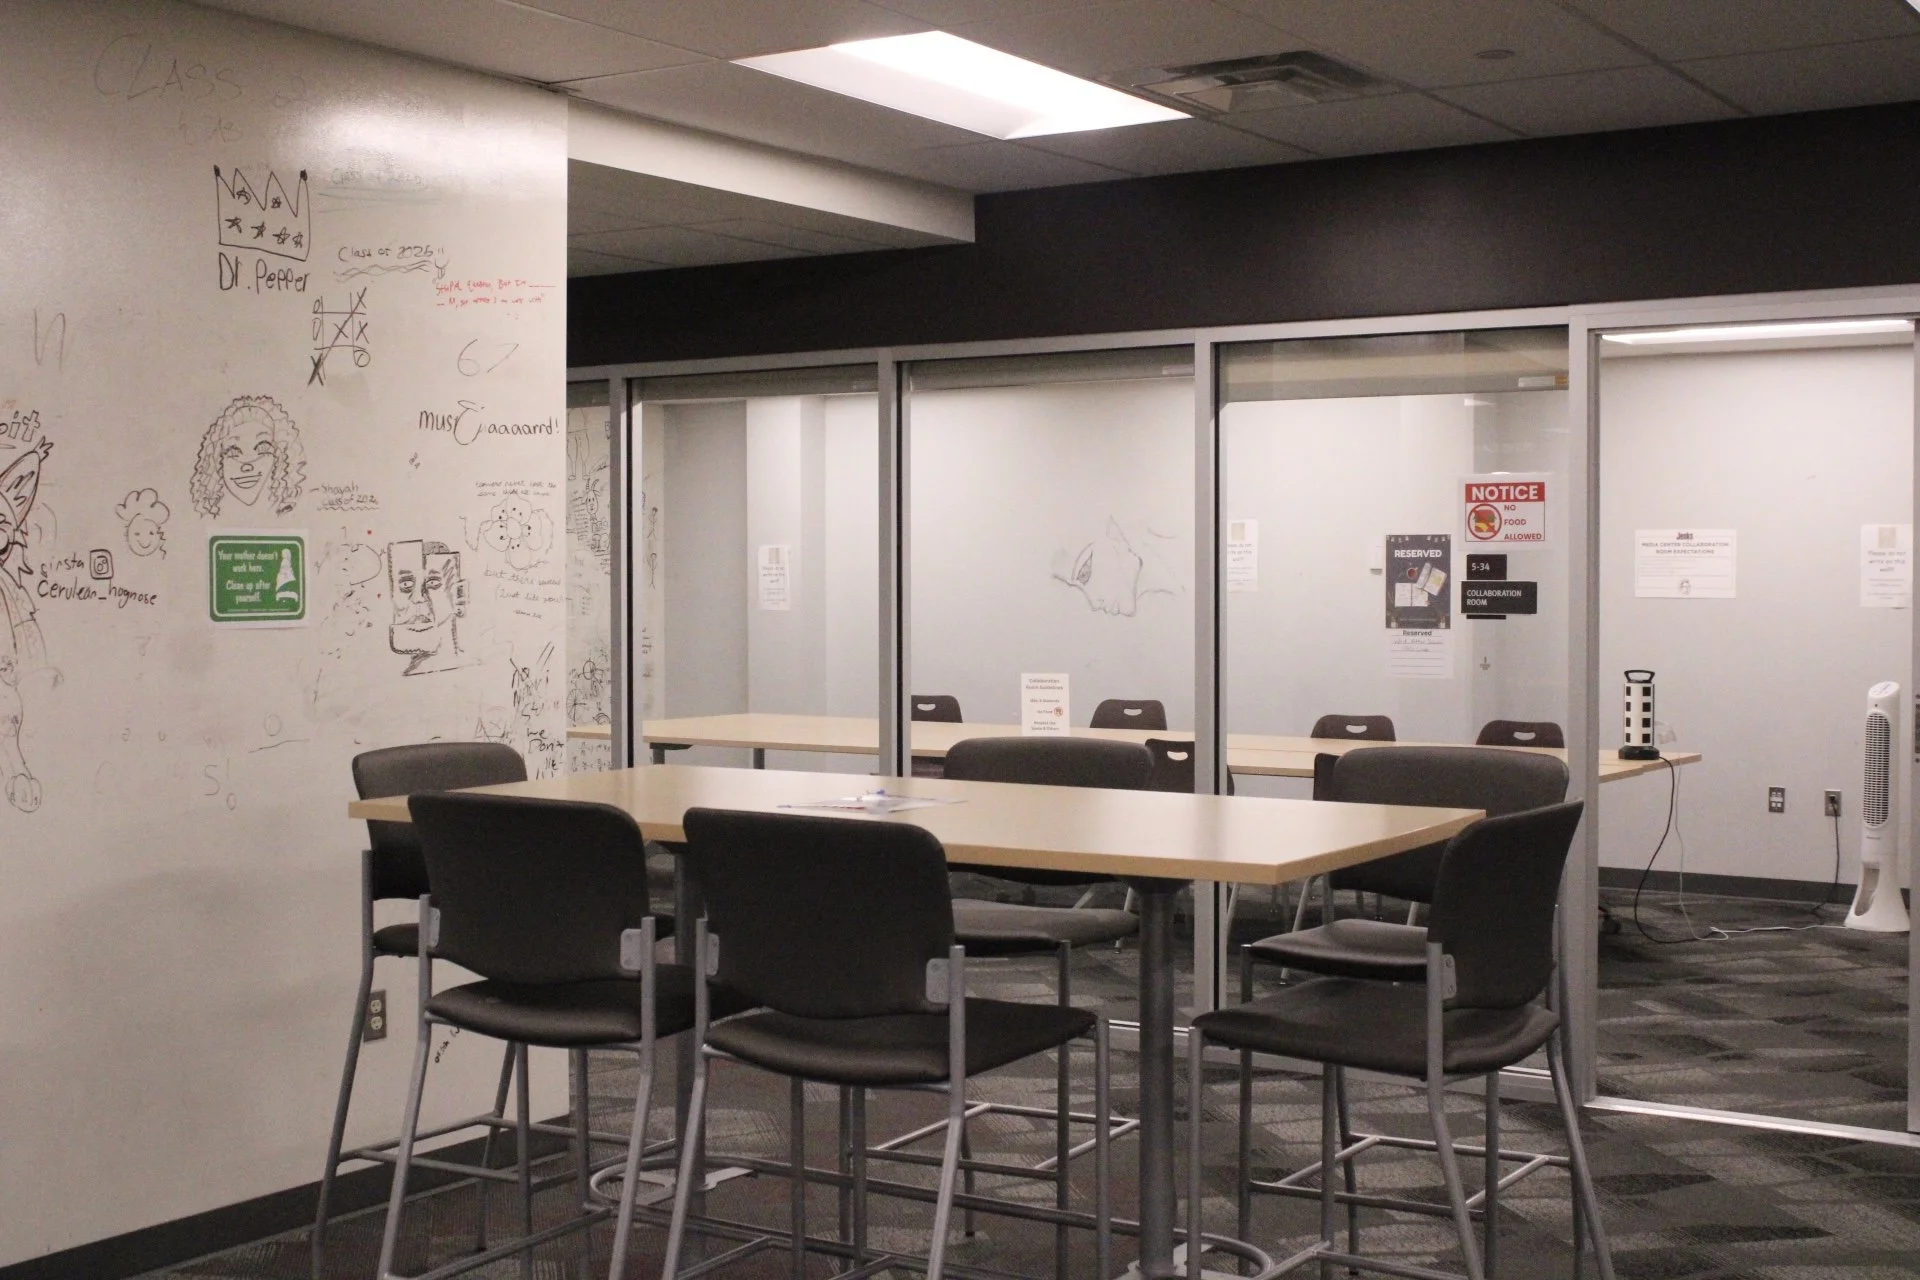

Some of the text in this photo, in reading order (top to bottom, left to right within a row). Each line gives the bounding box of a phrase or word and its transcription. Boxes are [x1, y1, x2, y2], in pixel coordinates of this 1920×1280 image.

[338, 246, 372, 263] Class
[255, 258, 310, 295] Pepper
[1471, 484, 1539, 501] NOTICE
[1503, 504, 1517, 512] NO
[1503, 518, 1527, 527] FOOD
[1503, 533, 1543, 541] ALLOWED
[218, 550, 232, 560] Your
[234, 550, 255, 560] mother
[1394, 549, 1443, 559] RESERVED
[1471, 562, 1491, 572] 5-34
[1466, 589, 1523, 598] COLLABORATION
[1466, 598, 1489, 607] ROOM
